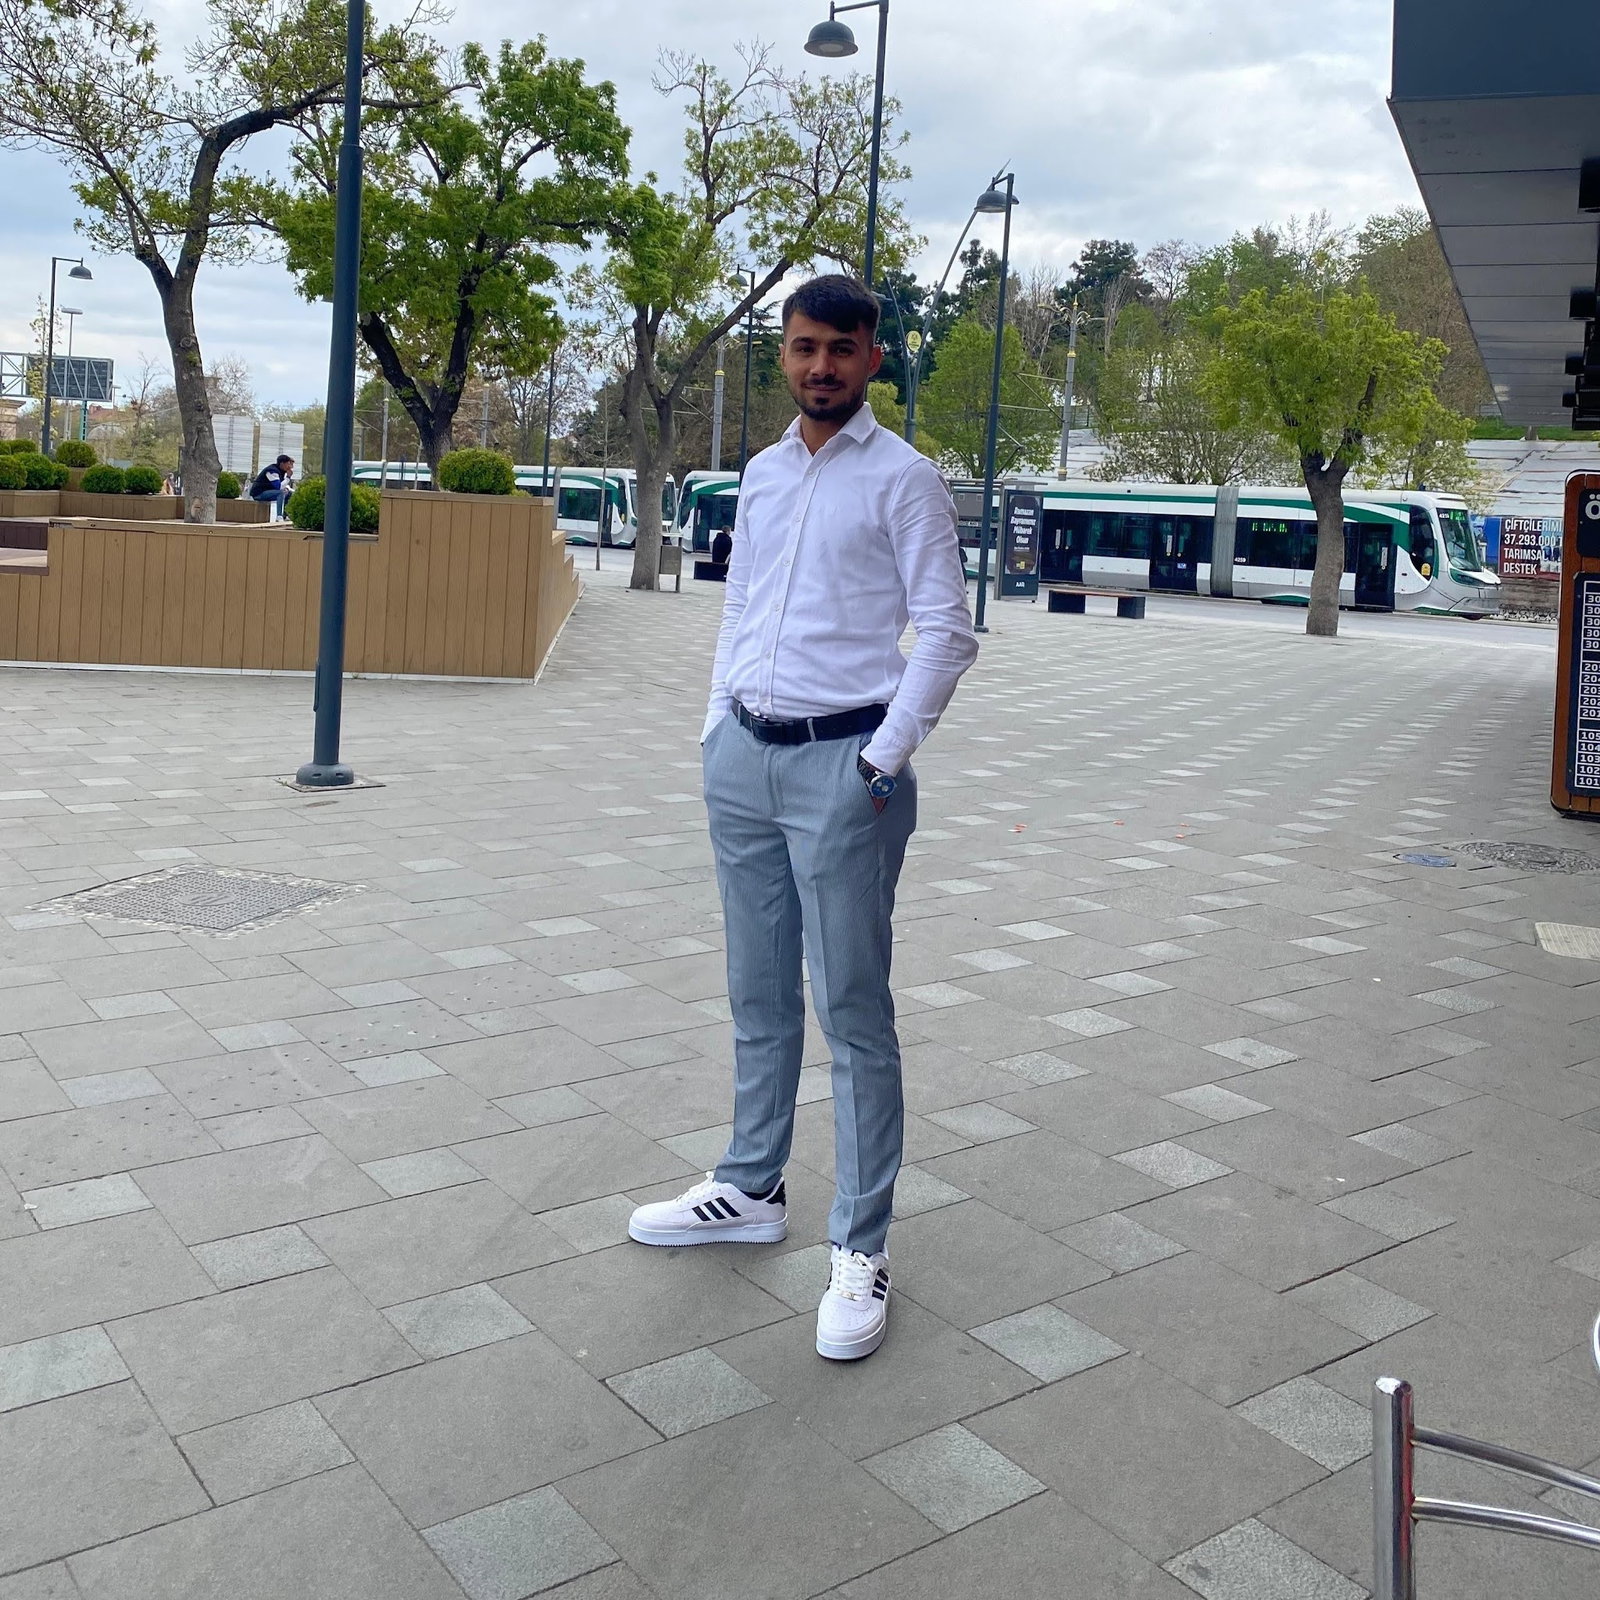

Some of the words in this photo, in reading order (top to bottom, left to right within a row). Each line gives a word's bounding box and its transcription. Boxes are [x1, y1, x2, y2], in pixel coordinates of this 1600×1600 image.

[1504, 533, 1556, 547] 37.293.000
[1504, 548, 1549, 561] TARIMSAL
[1503, 562, 1537, 575] DESTEK
[1579, 766, 1600, 774] 102
[1579, 777, 1599, 786] 101
